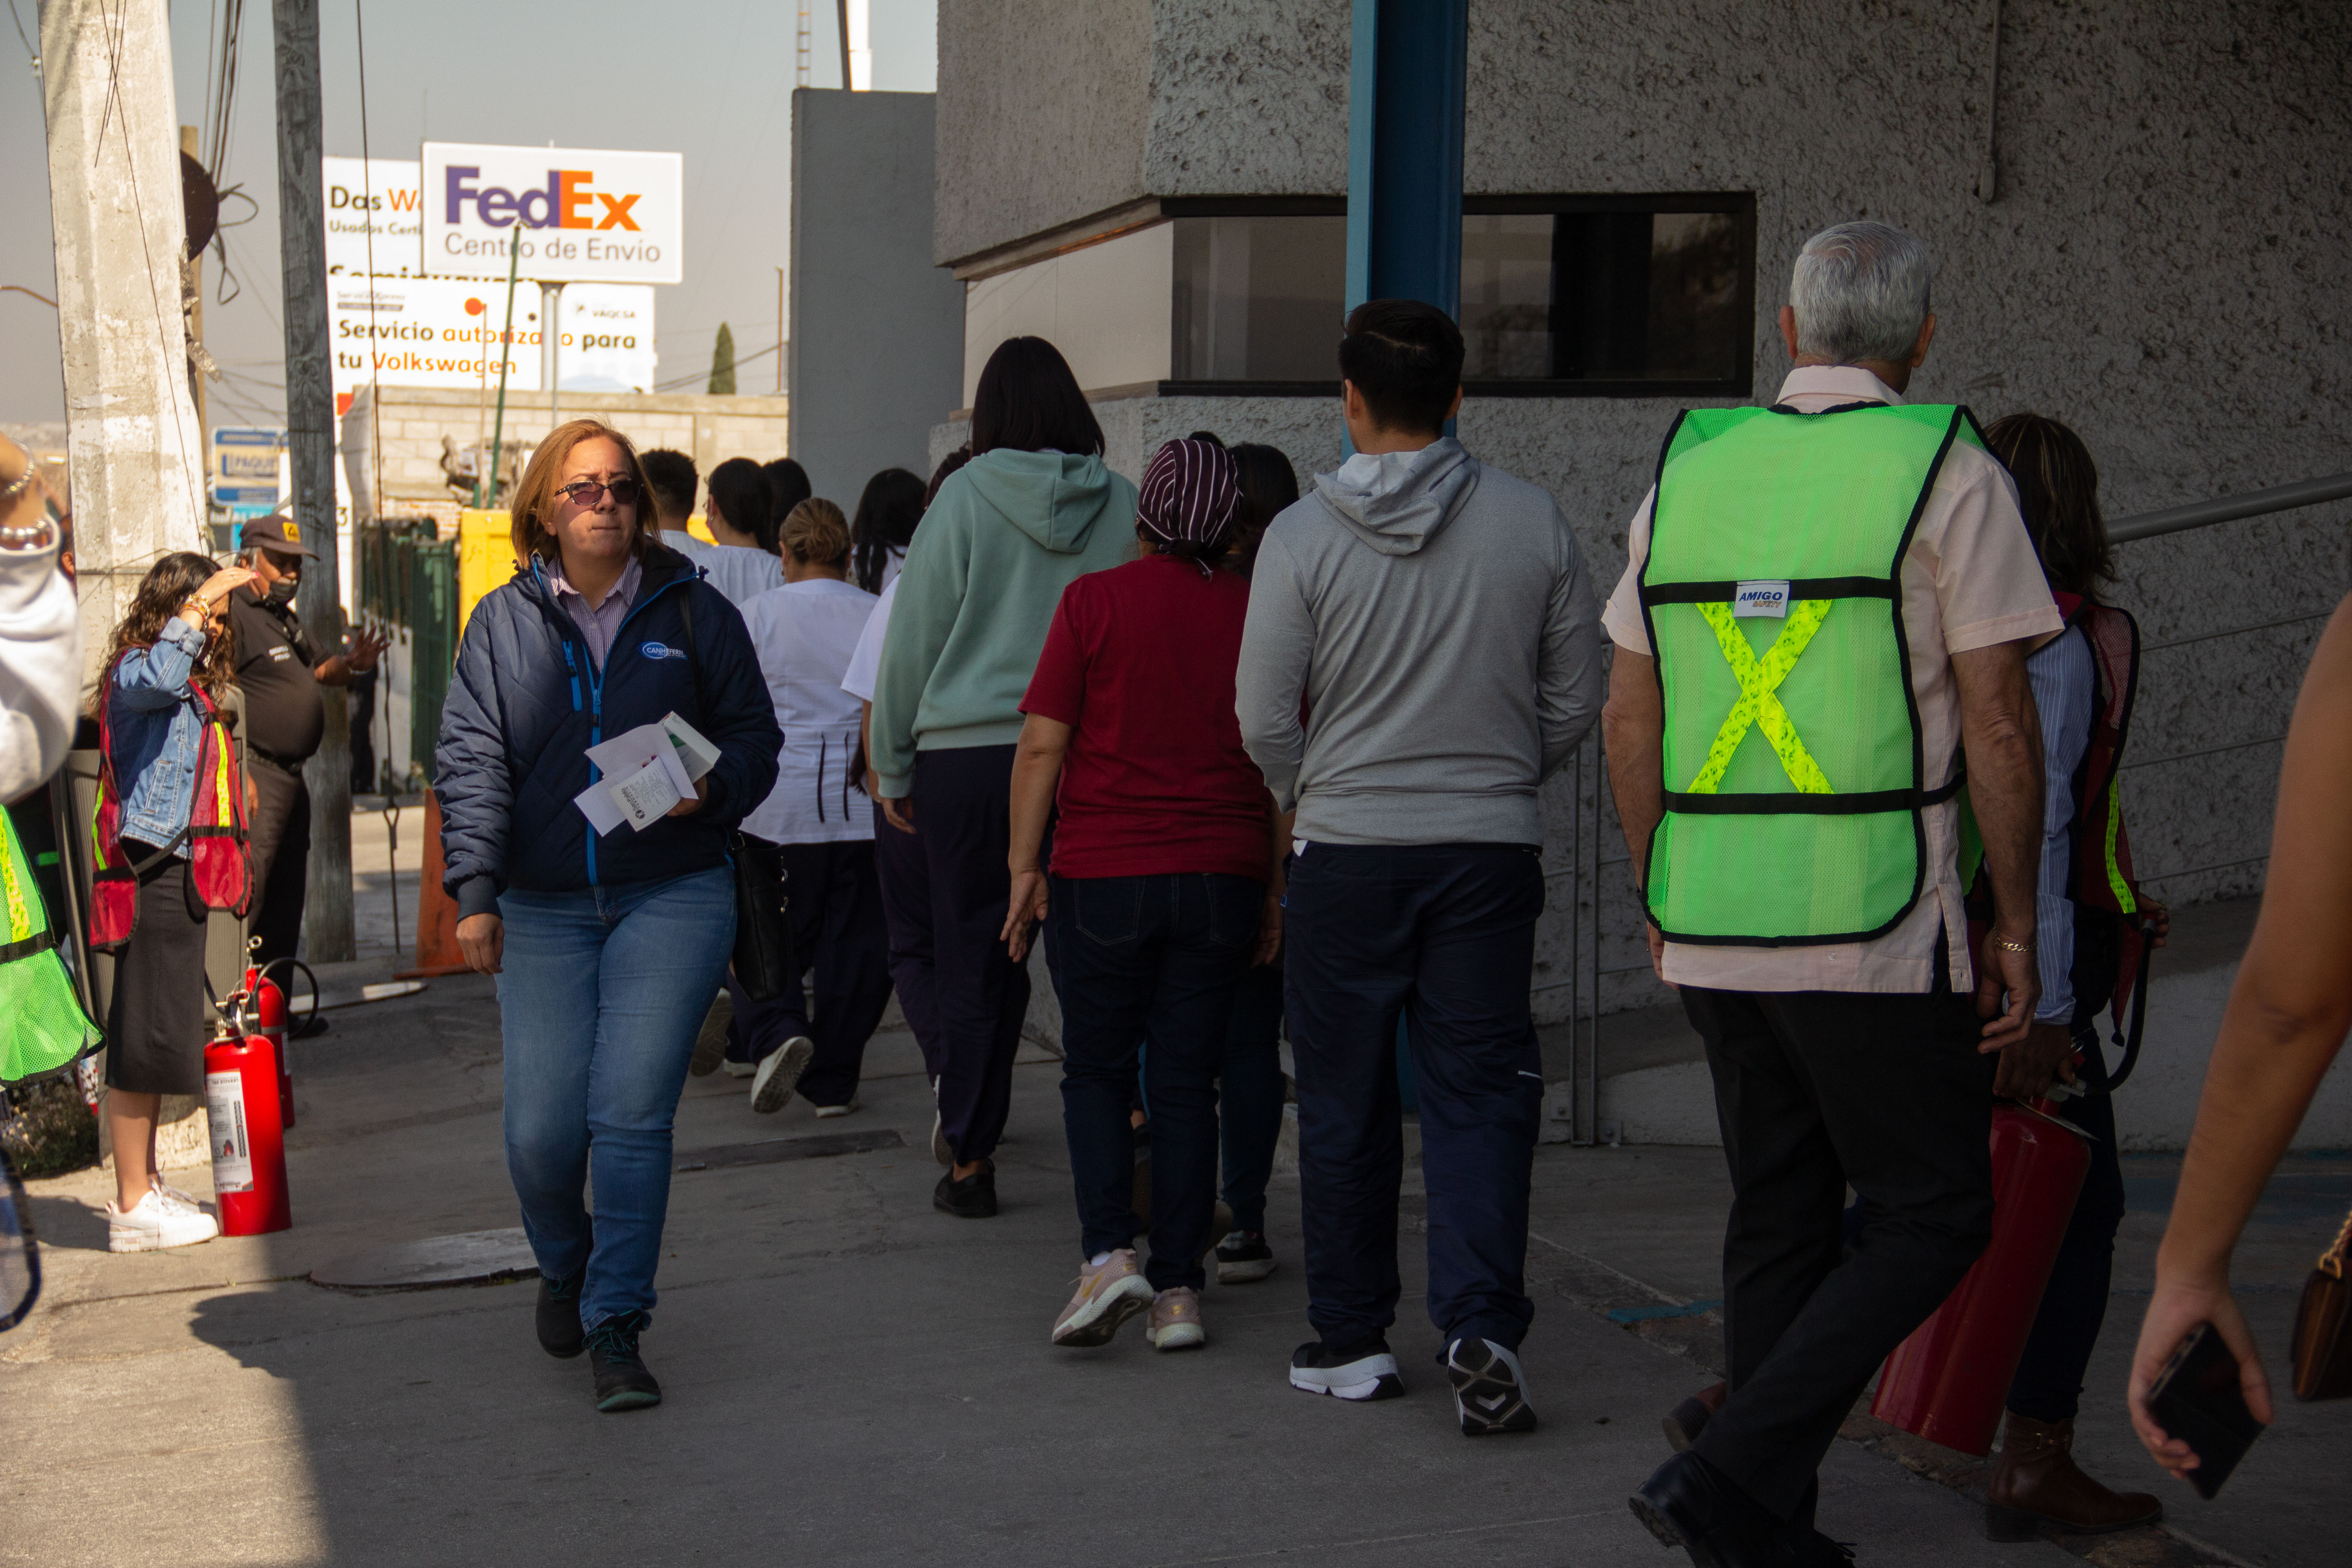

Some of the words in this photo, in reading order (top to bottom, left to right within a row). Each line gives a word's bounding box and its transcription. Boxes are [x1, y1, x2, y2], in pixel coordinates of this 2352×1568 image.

[331, 186, 382, 211] Das
[387, 188, 421, 211] W
[445, 165, 642, 232] FedEx
[330, 220, 383, 234] Usados
[545, 237, 577, 260] de
[588, 238, 661, 262] Envío
[338, 319, 434, 341] Servicio
[442, 325, 573, 346] autorizao
[583, 333, 636, 352] para
[338, 351, 362, 369] tu
[371, 352, 516, 378] Volkswagen
[1739, 591, 1783, 601] AMIGO
